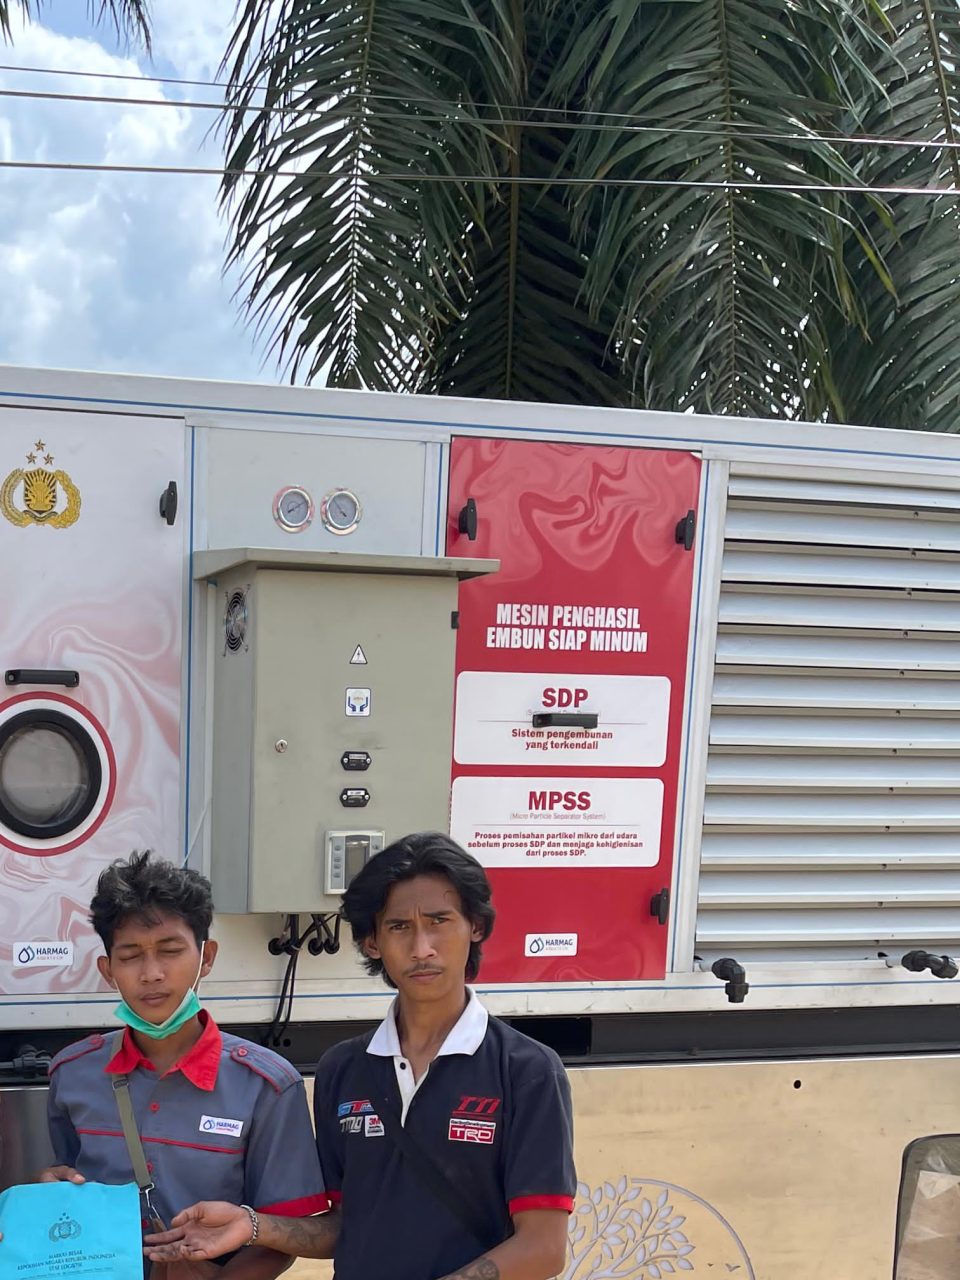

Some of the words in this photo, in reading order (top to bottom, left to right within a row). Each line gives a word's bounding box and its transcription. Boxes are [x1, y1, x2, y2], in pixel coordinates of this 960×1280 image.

[497, 603, 548, 626] MESIN
[553, 606, 640, 629] PENGHASIL
[486, 627, 544, 649] EMBUN
[549, 629, 586, 650] SIAP
[590, 631, 647, 652] MINUM
[542, 688, 588, 707] SDP
[512, 728, 544, 738] Sistem
[547, 730, 613, 740] pengembunan
[526, 741, 548, 750] yang
[551, 740, 598, 749] terkendali
[528, 791, 591, 811] MPSS
[503, 832, 544, 841] pemisahan
[546, 832, 576, 841] partikel
[578, 832, 598, 840] mikro
[600, 832, 615, 840] dari
[616, 832, 638, 840] udara
[563, 841, 594, 850] menjaga
[596, 841, 643, 850] kehigienisan
[542, 850, 567, 858] proses
[452, 1128, 492, 1142] TRD
